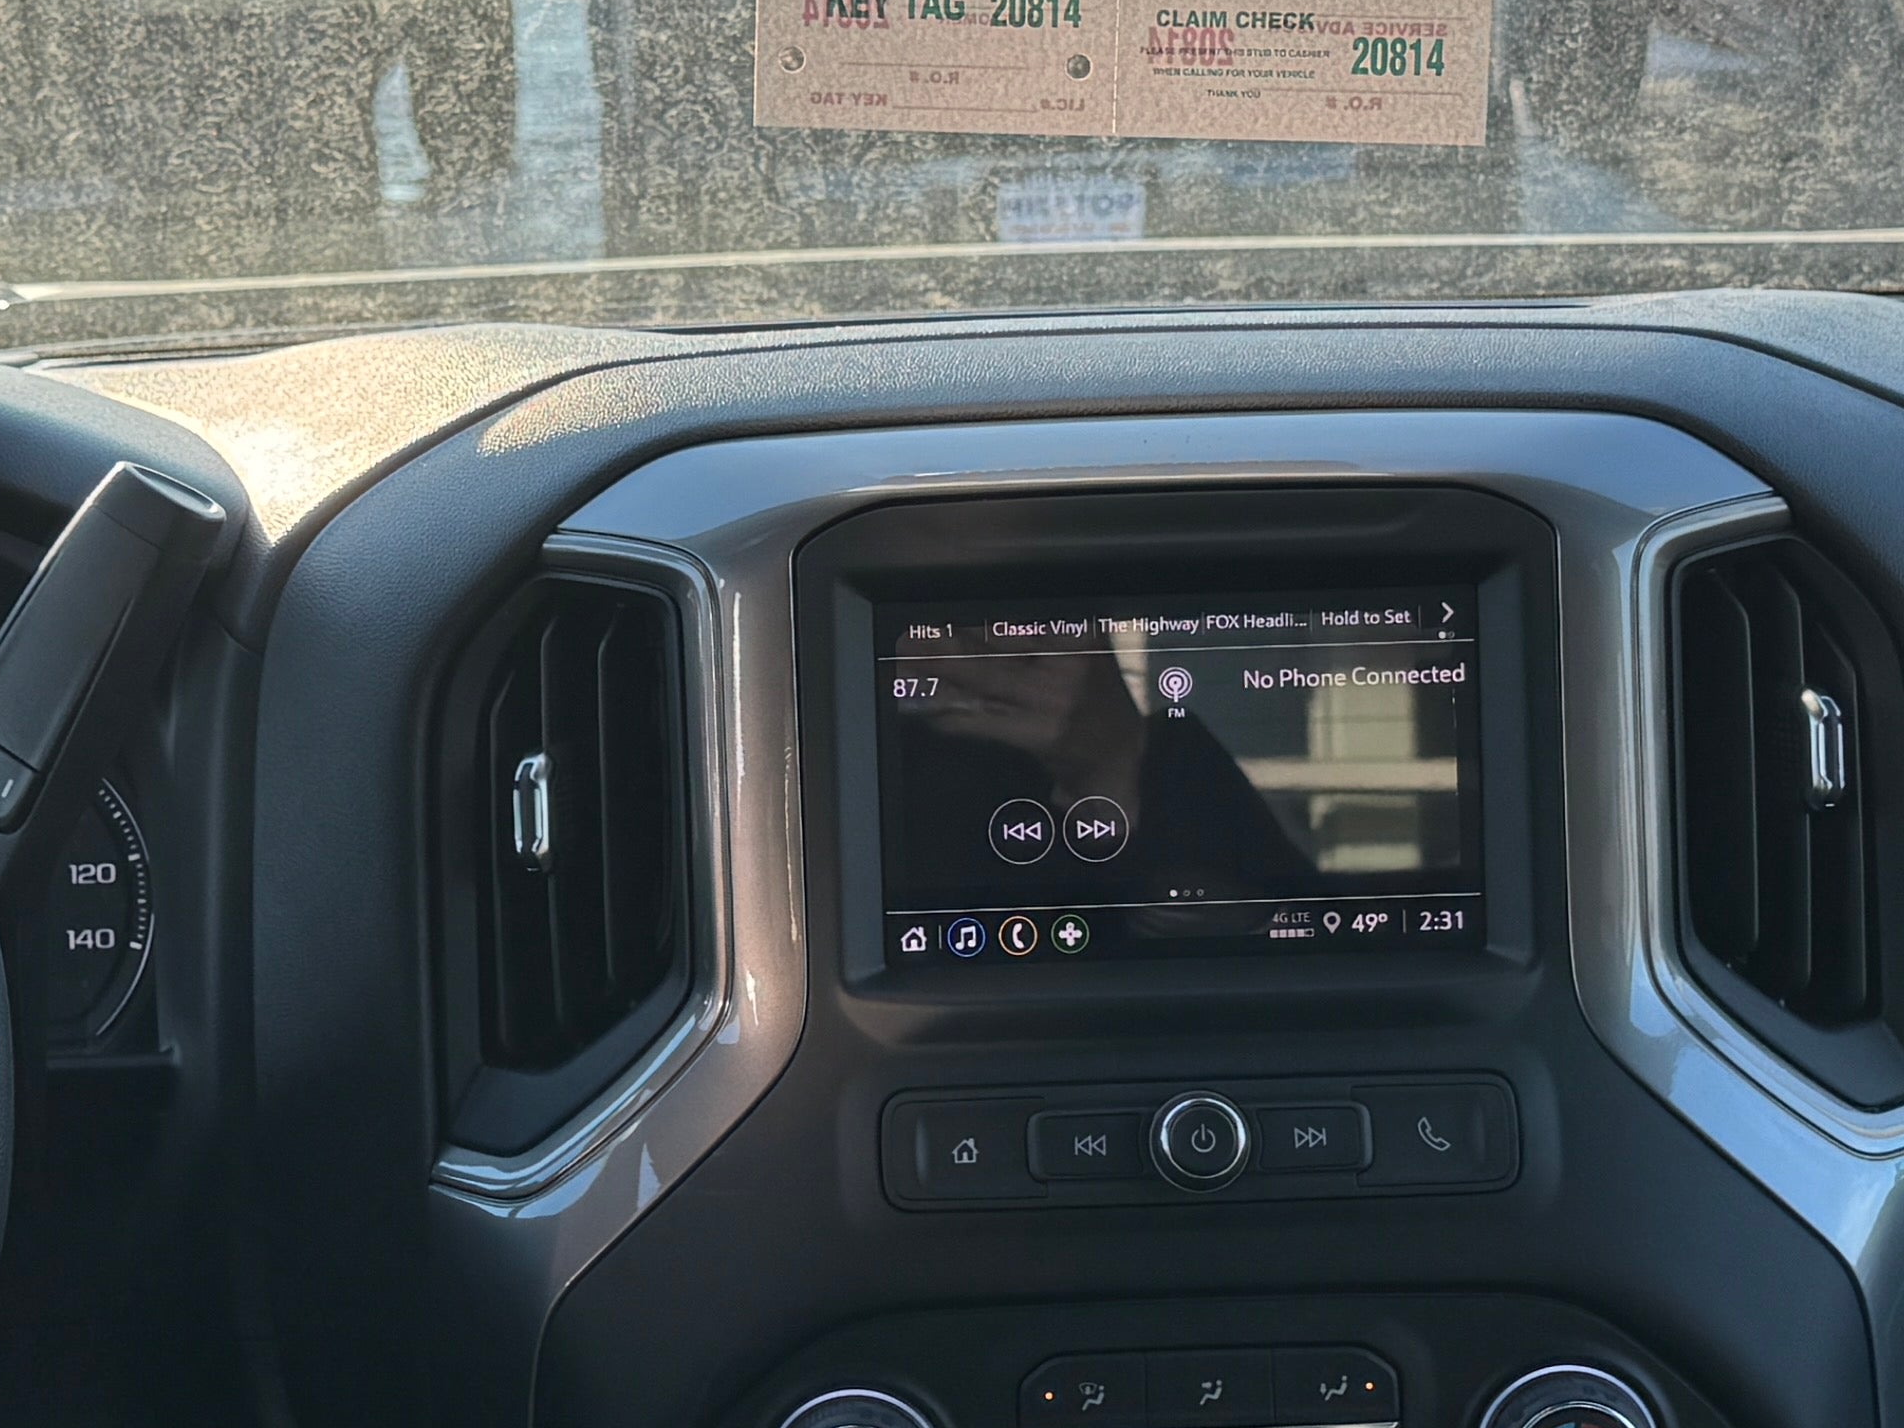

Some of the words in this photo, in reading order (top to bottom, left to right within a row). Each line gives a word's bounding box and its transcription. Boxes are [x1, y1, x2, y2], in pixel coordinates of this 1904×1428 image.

[1156, 10, 1228, 28] CLAIM
[1236, 12, 1315, 31] CHECK
[1351, 36, 1445, 77] 20814
[1098, 618, 1127, 633] The
[1132, 615, 1199, 635] Highway
[1206, 614, 1239, 629] FOX
[1244, 612, 1308, 628] Headli...
[1321, 610, 1358, 626] Hold
[1364, 611, 1380, 625] to
[1385, 609, 1412, 625] Set
[909, 623, 941, 639] Hits
[947, 623, 954, 637] 1
[992, 621, 1046, 637] Classic
[1049, 618, 1088, 638] Vinyl
[1243, 669, 1274, 689] No
[1279, 667, 1347, 689] Phone
[1351, 662, 1467, 686] Connected
[893, 677, 939, 698] 87.7
[1168, 707, 1186, 719] FM
[68, 863, 116, 885] 120
[1271, 912, 1288, 924] 4G
[1291, 912, 1311, 923] LTE
[1419, 910, 1464, 931] 2:31
[65, 928, 115, 950] 140
